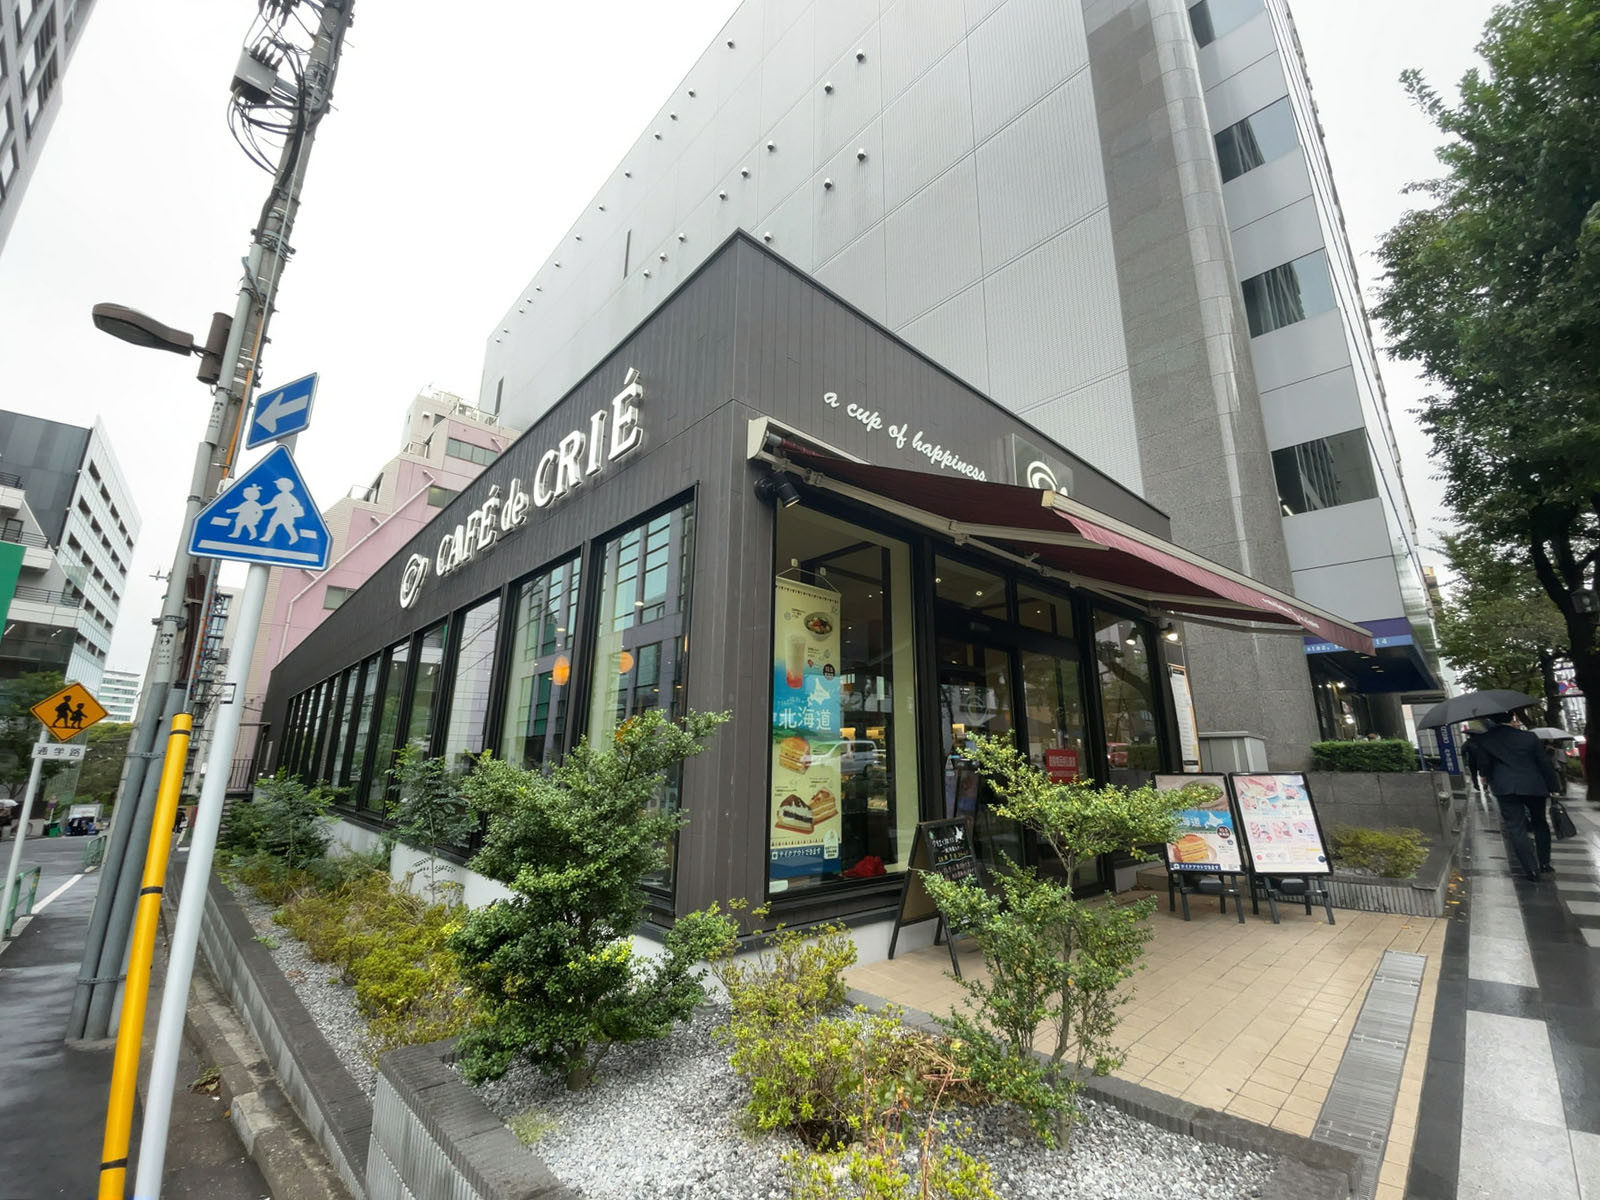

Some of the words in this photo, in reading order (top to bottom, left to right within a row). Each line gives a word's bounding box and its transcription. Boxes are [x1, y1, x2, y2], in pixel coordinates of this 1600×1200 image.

[823, 391, 840, 408] a
[846, 402, 883, 432] cup
[888, 423, 909, 449] of
[436, 485, 500, 577] CAFÉ
[500, 478, 530, 533] de
[533, 367, 644, 508] CRIÉ
[779, 706, 832, 730] 北海道
[38, 745, 81, 758] 通学路
